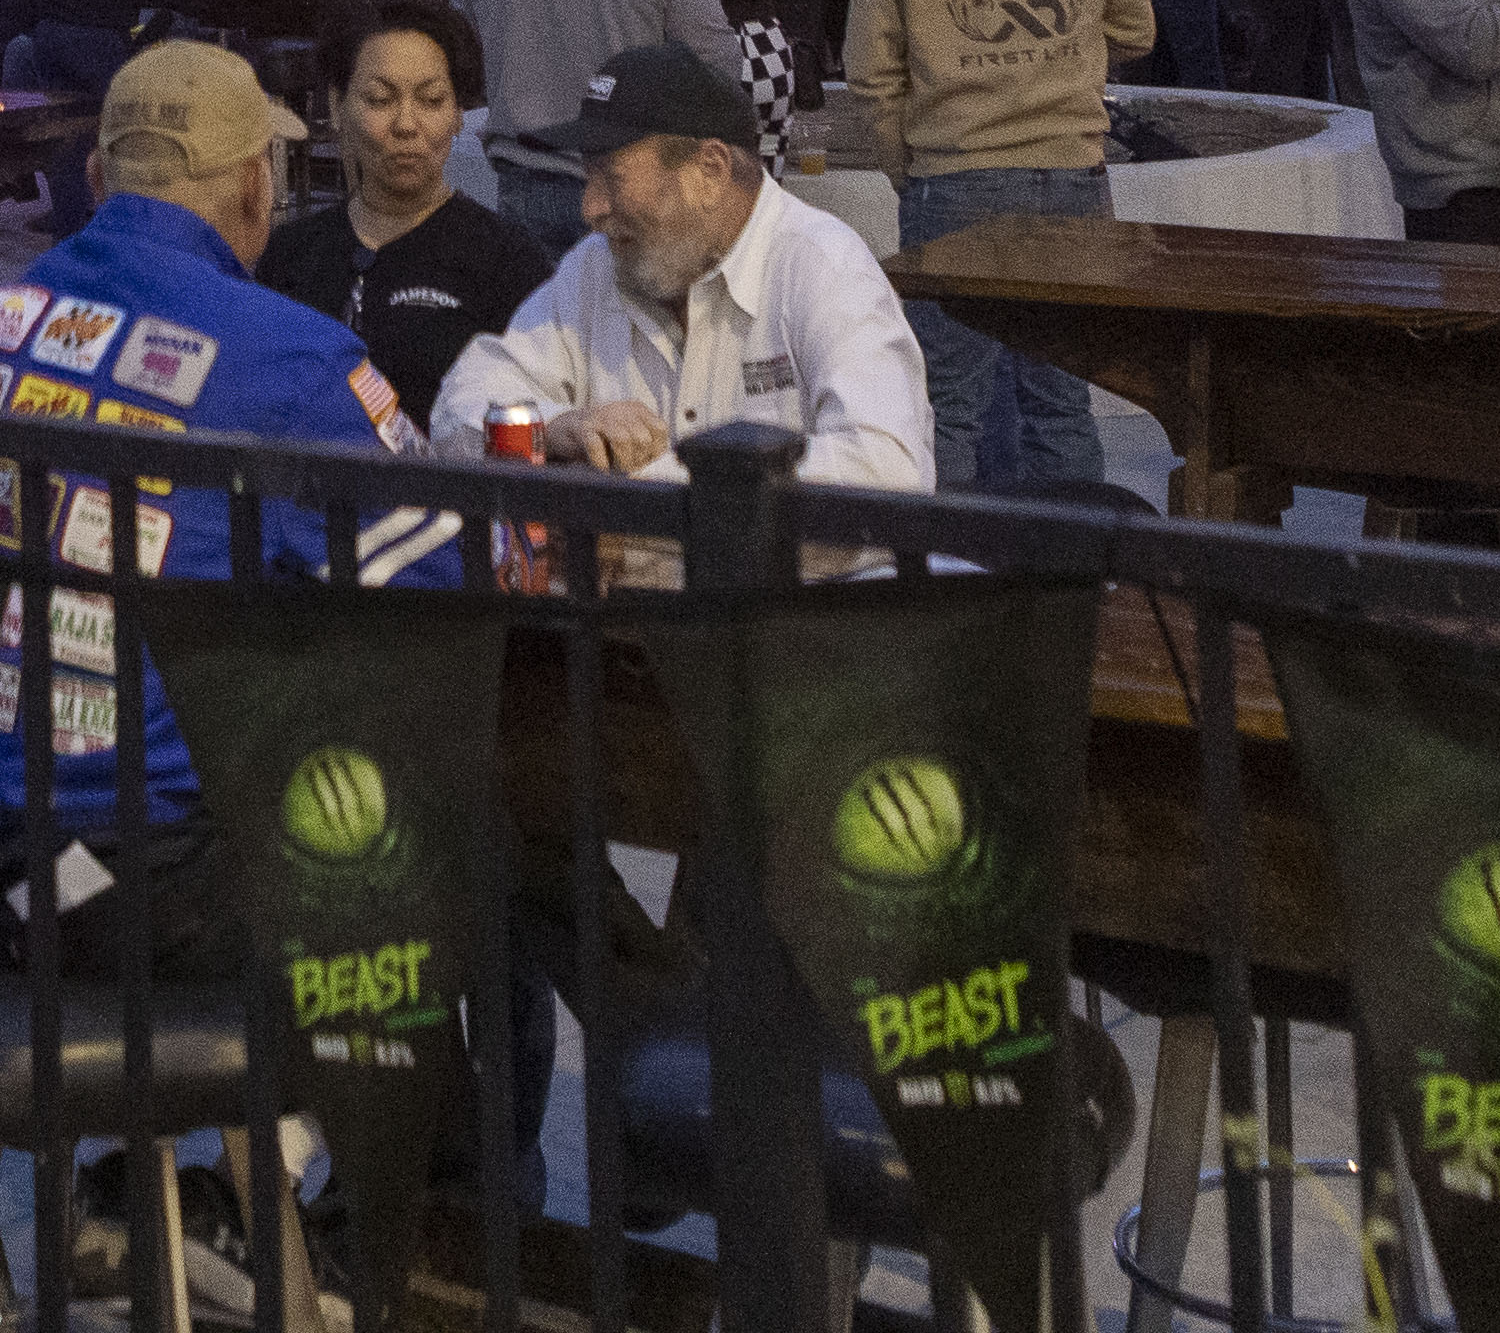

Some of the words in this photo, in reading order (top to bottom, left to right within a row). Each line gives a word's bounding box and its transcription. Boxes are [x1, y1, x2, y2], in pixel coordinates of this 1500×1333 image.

[389, 286, 461, 309] JAMESON
[284, 938, 432, 1031] BEAST
[857, 960, 1030, 1076] BEAST
